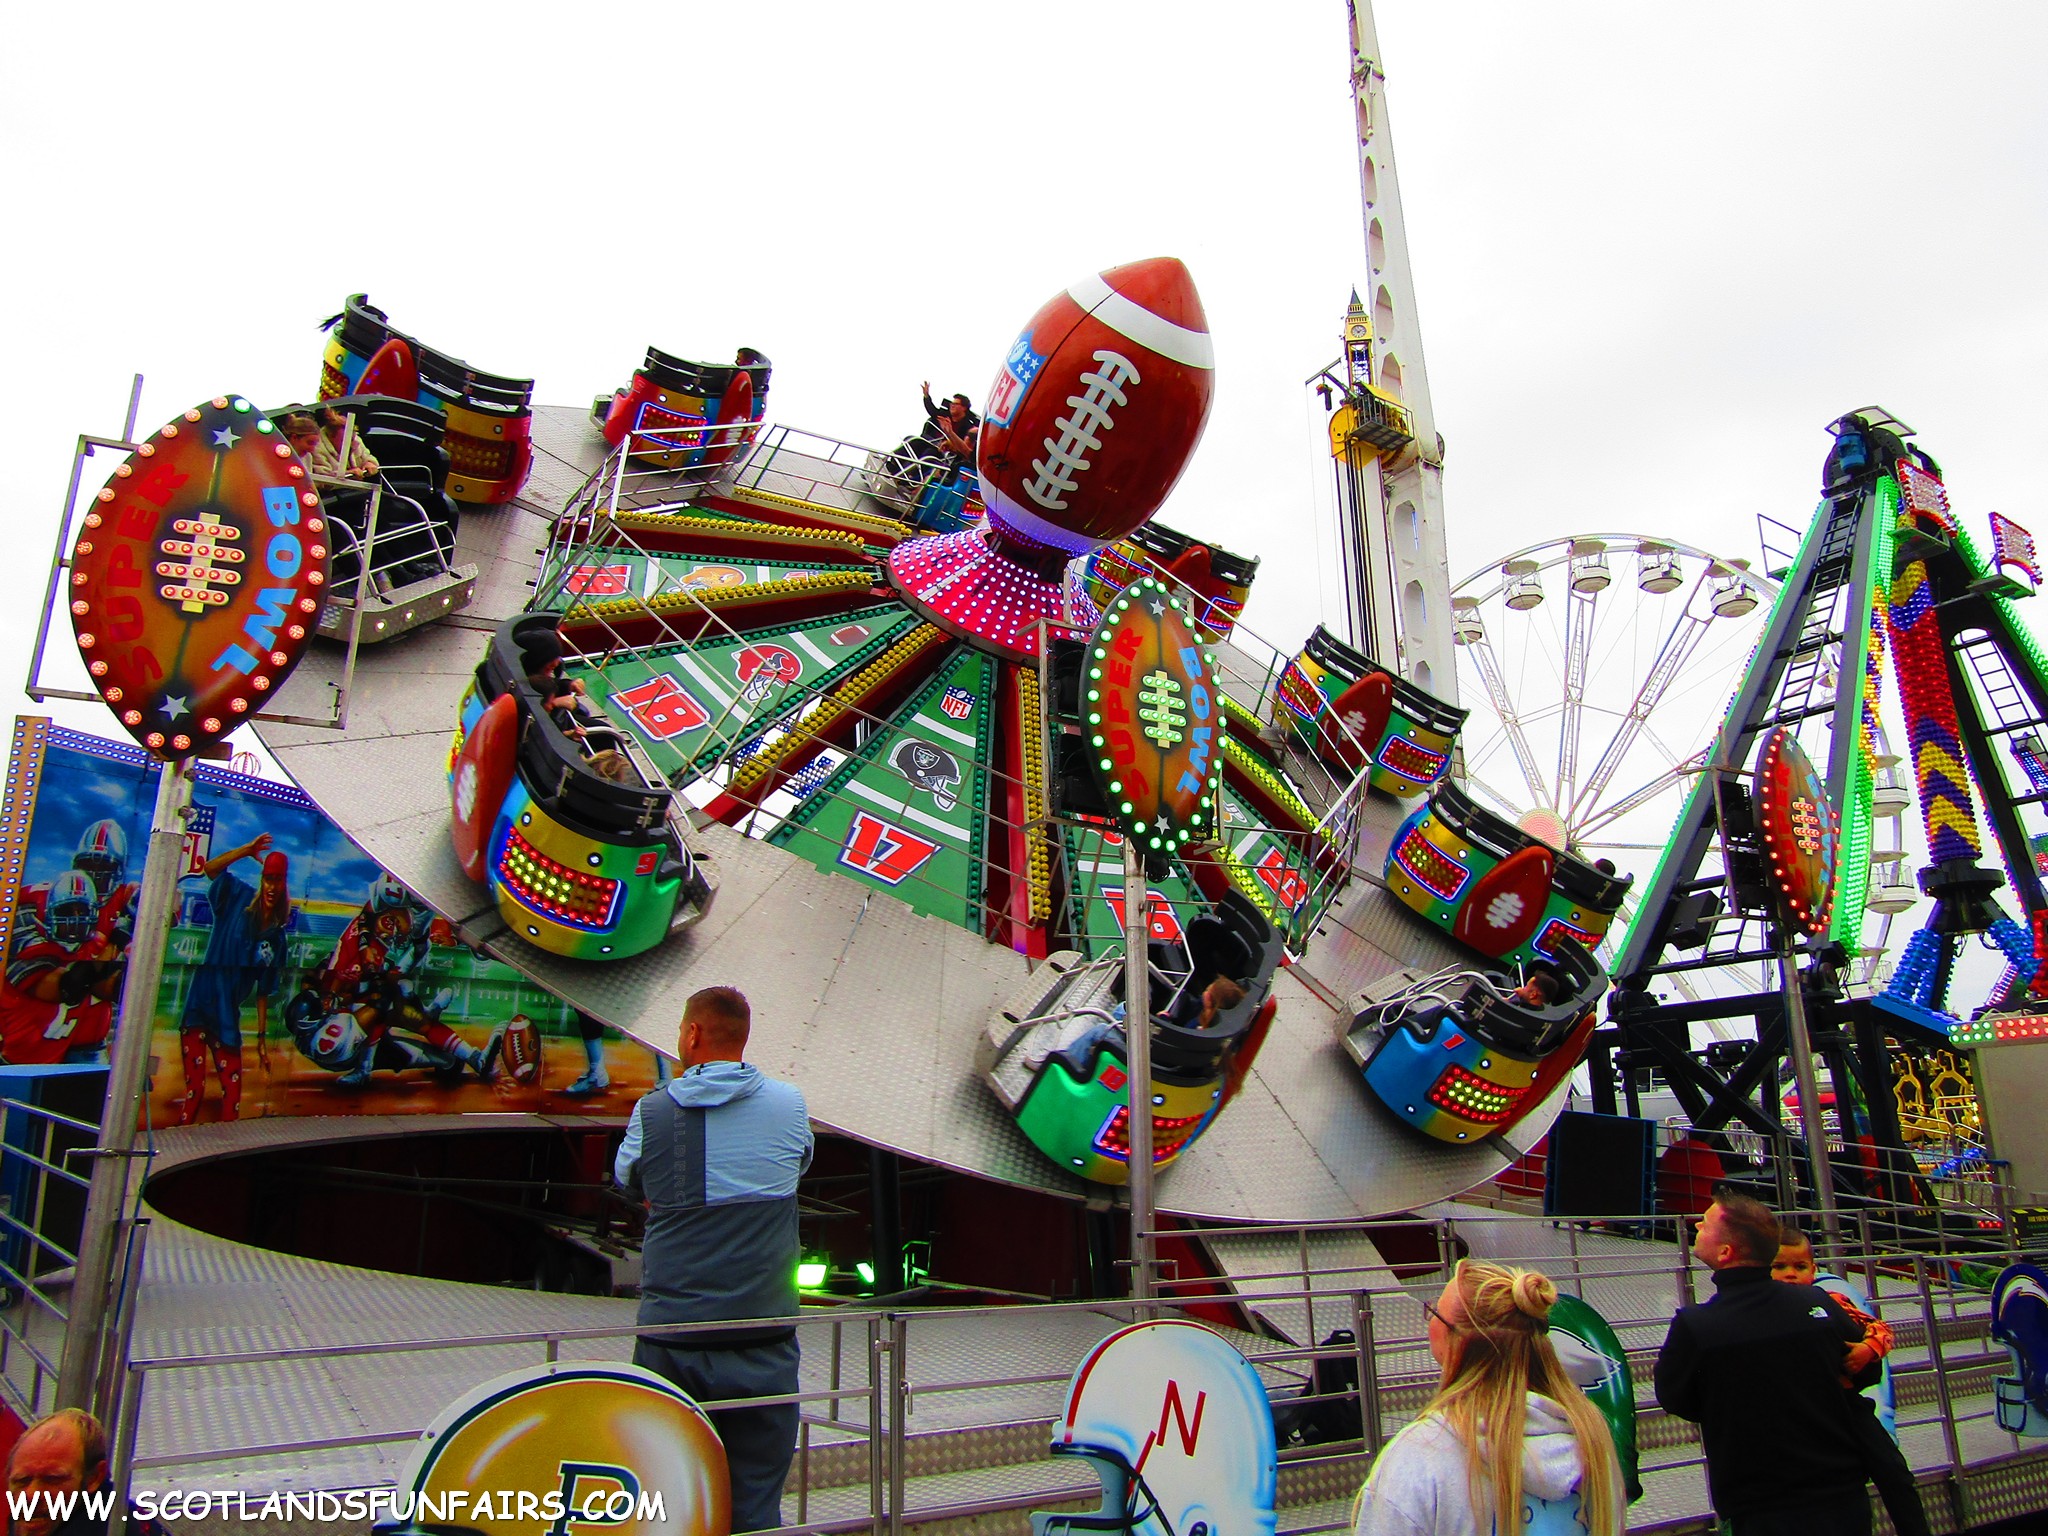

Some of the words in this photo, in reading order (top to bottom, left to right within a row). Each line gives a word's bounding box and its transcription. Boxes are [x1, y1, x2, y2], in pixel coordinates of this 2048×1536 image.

[106, 463, 190, 686] SUPER
[210, 486, 302, 675] BOWL
[610, 673, 711, 741] 18
[941, 695, 968, 718] NFL
[1107, 627, 1150, 799] SUPER
[1176, 647, 1212, 795] BOWL
[634, 851, 658, 876] 9
[840, 810, 941, 885] 17
[1097, 1064, 1128, 1093] 10
[1441, 1033, 1466, 1050] 1
[1156, 1378, 1206, 1458] N
